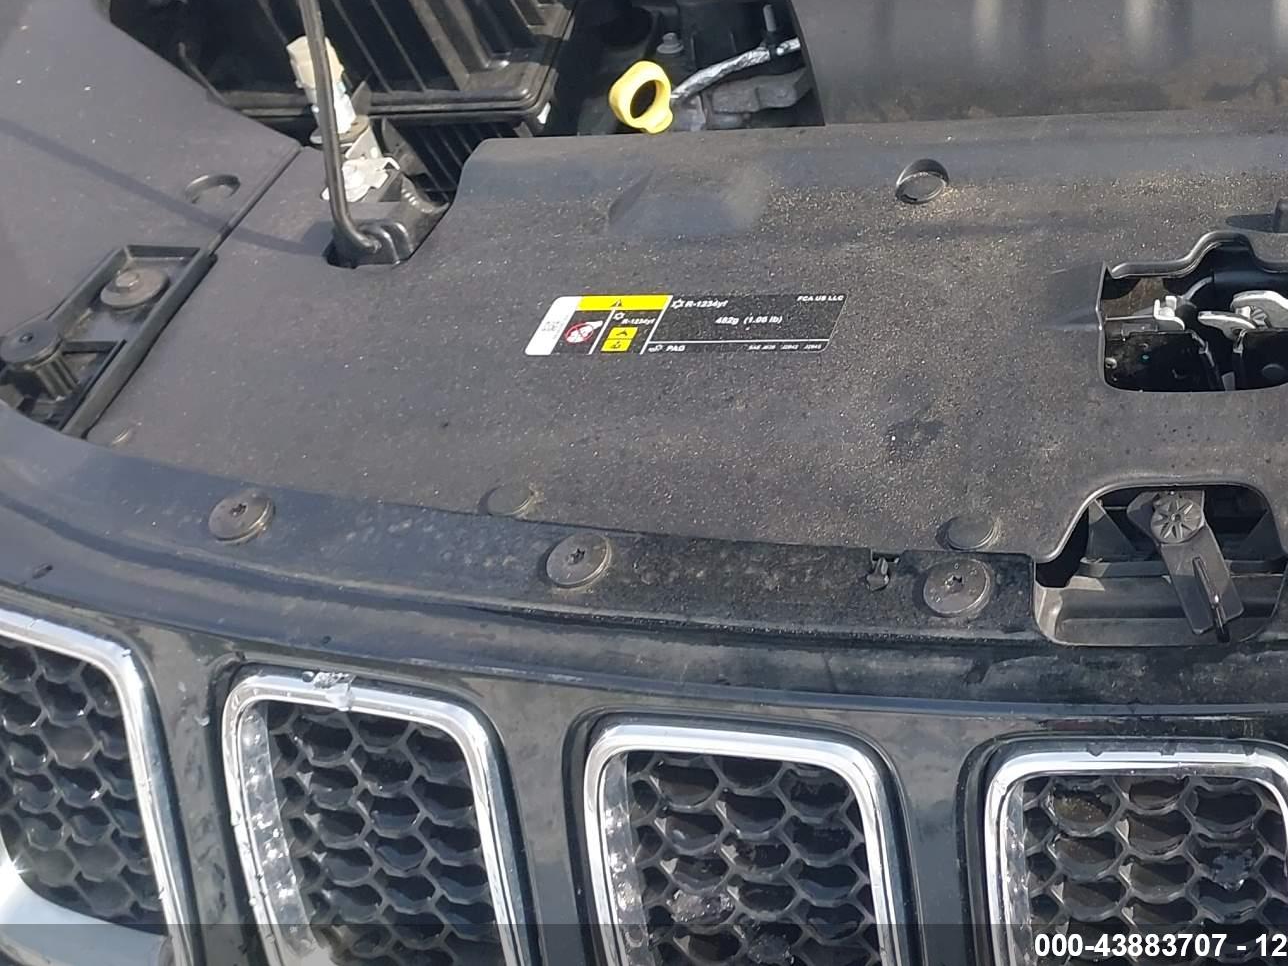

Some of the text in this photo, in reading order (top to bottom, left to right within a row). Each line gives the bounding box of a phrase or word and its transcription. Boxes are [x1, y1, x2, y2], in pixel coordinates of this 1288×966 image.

[685, 300, 728, 309] R-1234yf
[769, 315, 783, 324] lb)
[665, 344, 686, 352] PAG
